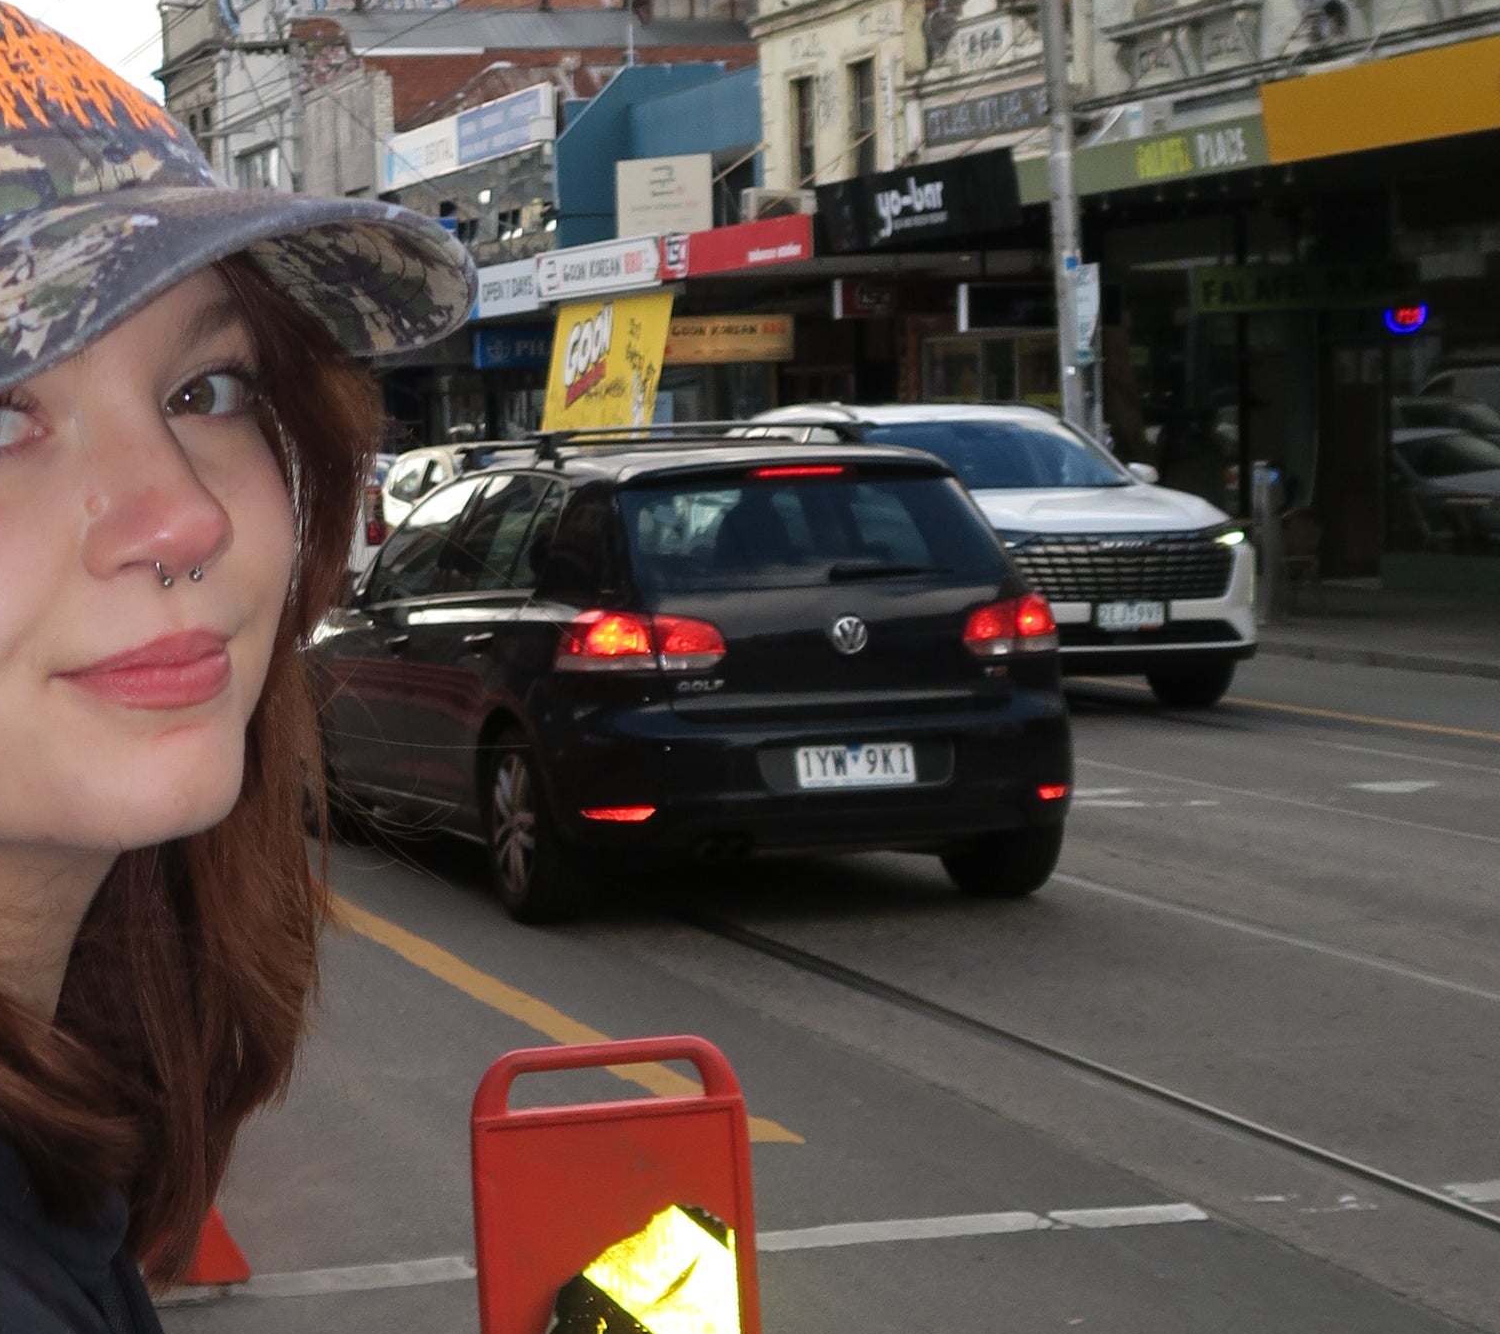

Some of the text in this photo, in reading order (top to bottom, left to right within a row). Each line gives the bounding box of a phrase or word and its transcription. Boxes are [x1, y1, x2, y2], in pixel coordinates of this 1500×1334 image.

[1197, 127, 1248, 168] PLACE
[875, 176, 944, 238] yo-bar
[481, 280, 504, 304] OPEN
[511, 275, 534, 298] DAYS
[563, 301, 614, 388] GOON
[676, 678, 725, 692] GOLF
[801, 747, 849, 779] 1YW
